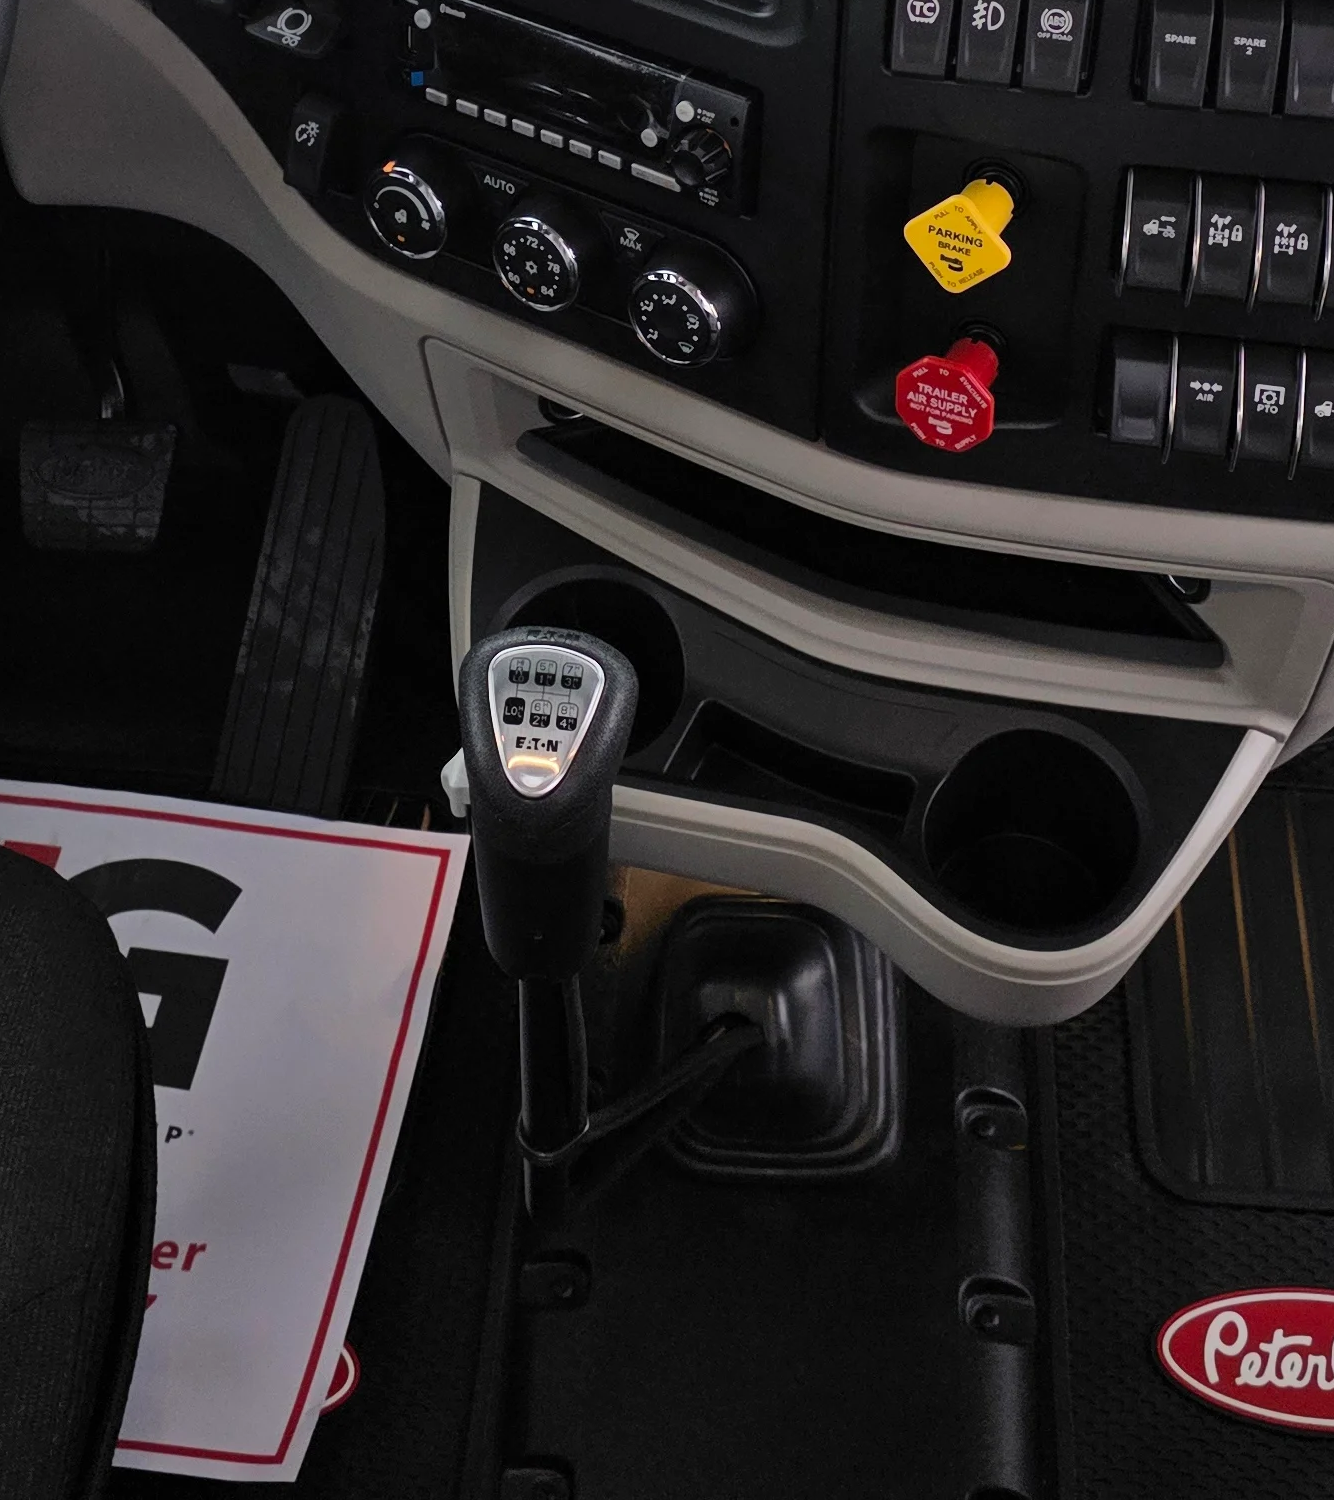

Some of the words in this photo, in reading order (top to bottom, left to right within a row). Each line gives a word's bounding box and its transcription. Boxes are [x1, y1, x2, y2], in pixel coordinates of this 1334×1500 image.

[913, 1, 935, 17] TC
[1047, 14, 1066, 27] ABS
[1036, 31, 1051, 40] OFF
[1052, 33, 1073, 42] ROAD
[1164, 33, 1197, 45] SPARE
[1233, 36, 1267, 48] SPARE
[1245, 47, 1253, 56] 2
[483, 174, 516, 195] AUTO
[933, 209, 950, 220] PULL
[954, 205, 964, 213] TO
[965, 215, 983, 235] APPLY
[525, 235, 539, 248] 72
[928, 224, 984, 248] PARKING
[620, 236, 643, 251] MAX
[937, 240, 971, 257] BRAKE
[547, 261, 560, 274] 78
[507, 271, 520, 284] 60
[929, 261, 944, 279] PUSH
[947, 280, 957, 288] TO
[958, 267, 986, 285] RELEASE
[540, 285, 554, 297] 84
[917, 382, 968, 405] TRAILER
[939, 368, 950, 376] TO
[959, 376, 988, 409] EVACUATE
[1195, 392, 1215, 402] AIR
[907, 391, 927, 405] AIR
[929, 397, 978, 418] SUPPLY
[909, 402, 925, 411] NOT
[925, 406, 941, 416] FOR
[1256, 403, 1279, 415] PTO
[935, 438, 946, 447] TO
[566, 665, 574, 674] 7
[564, 677, 572, 686] 3
[505, 706, 518, 716] LO
[534, 702, 541, 712] 6
[560, 705, 568, 715] 8
[532, 716, 541, 726] 2
[559, 719, 567, 728] 4
